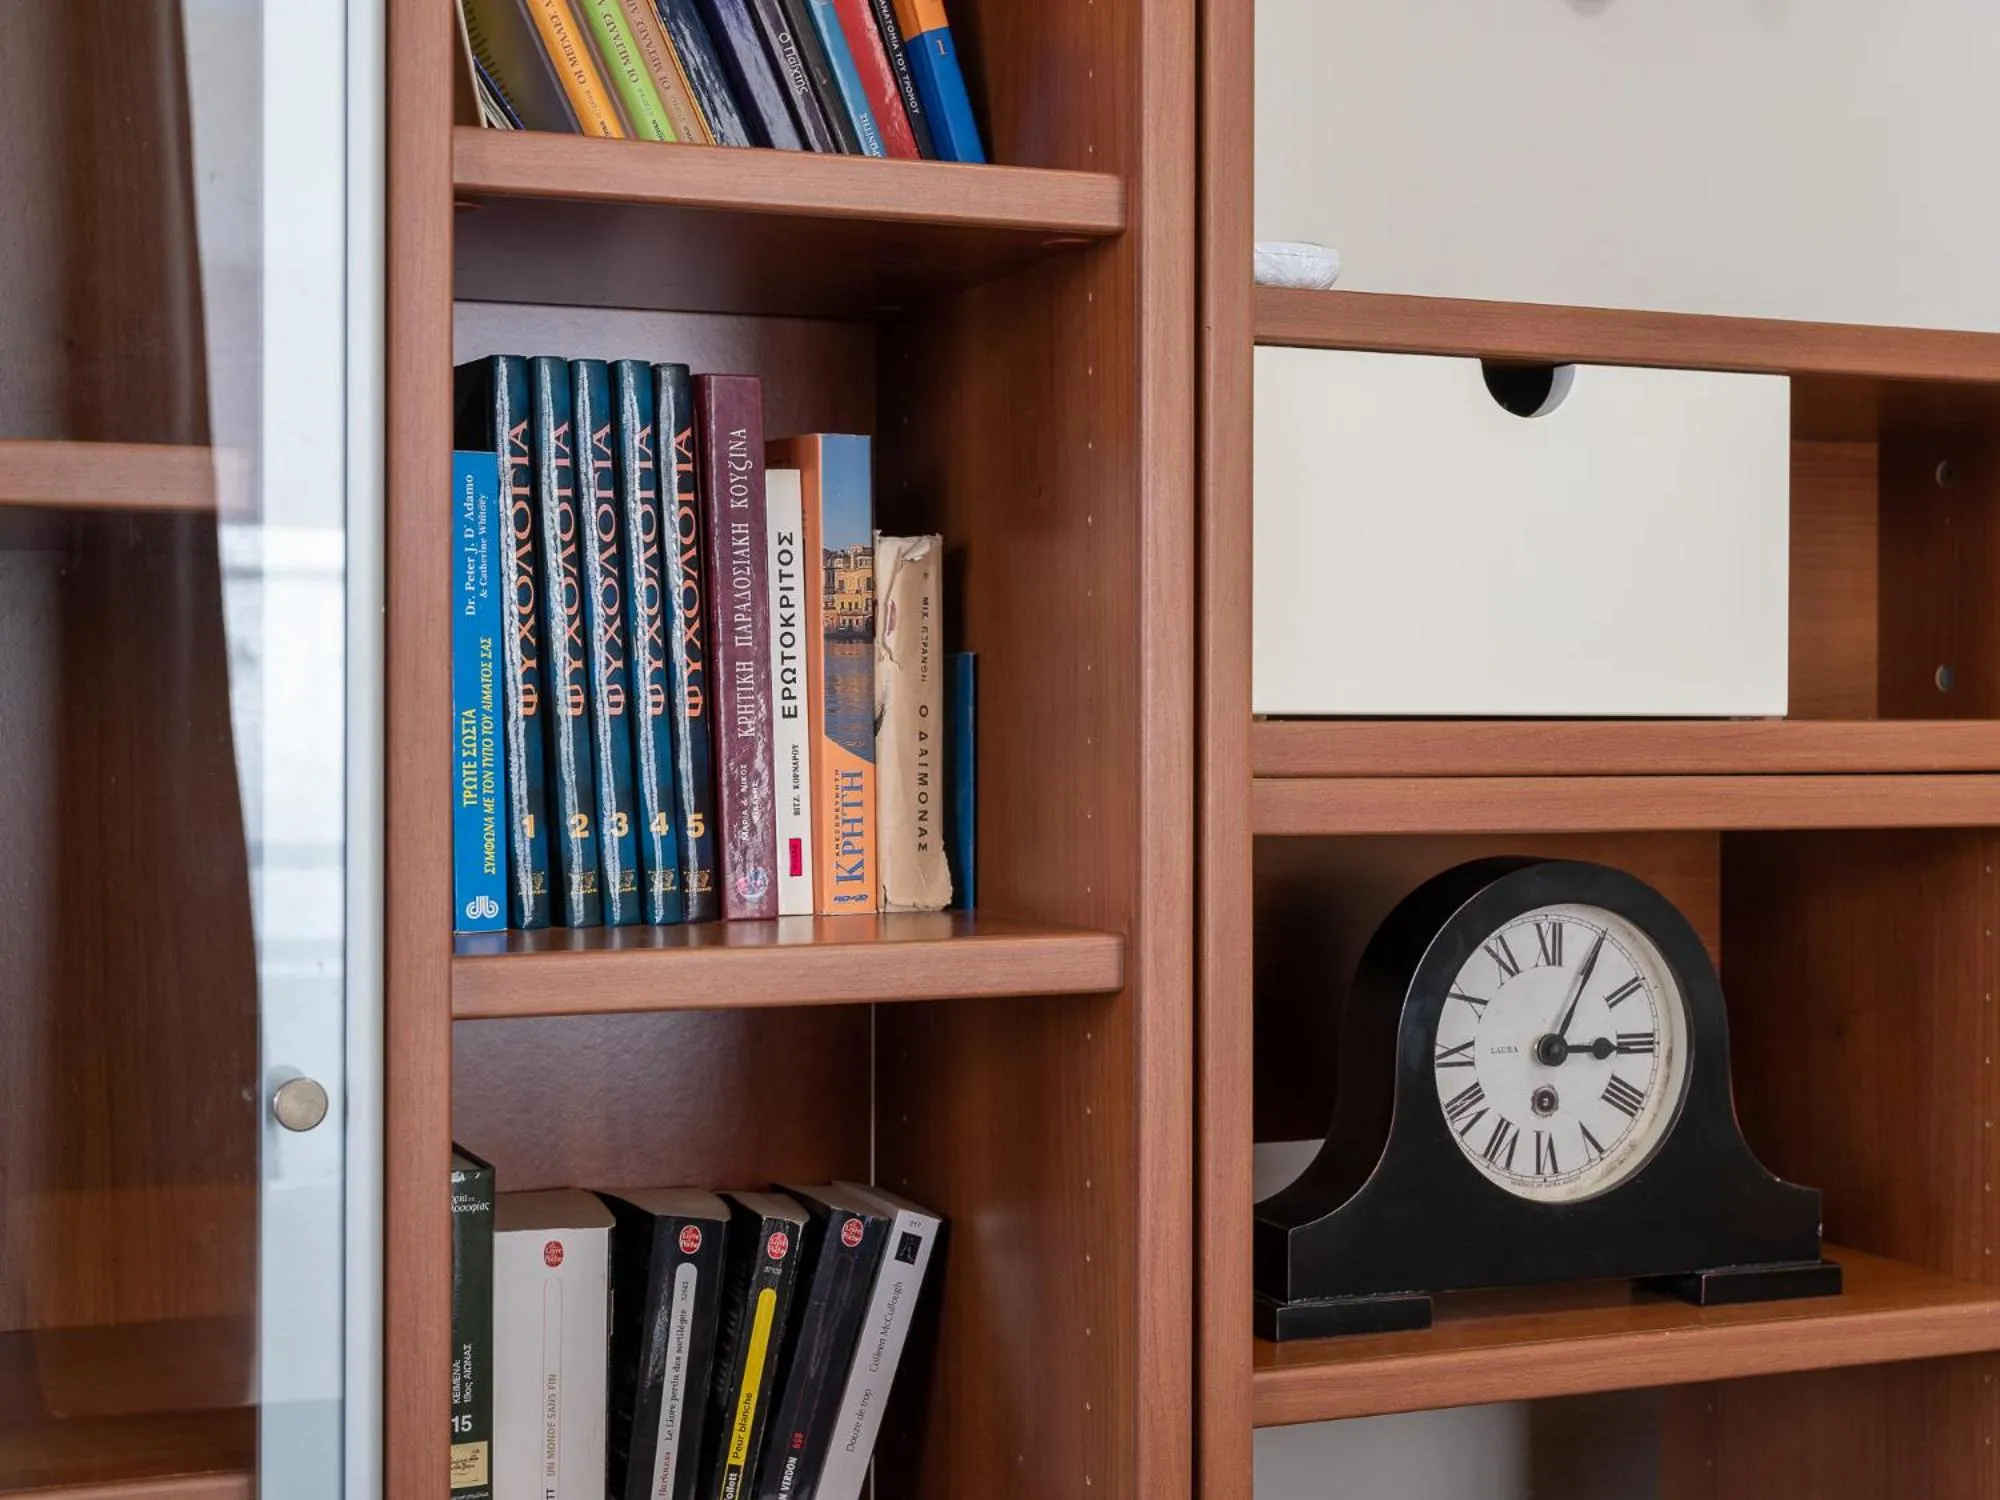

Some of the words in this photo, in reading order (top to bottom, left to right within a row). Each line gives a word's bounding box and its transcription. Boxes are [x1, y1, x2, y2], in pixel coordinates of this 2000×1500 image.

[894, 51, 908, 72] ΤΟΥ
[901, 74, 921, 115] ΤΡΟΜΟΥ
[463, 474, 475, 521] Adamo
[464, 543, 478, 554] J.
[479, 537, 488, 586] Catherine
[464, 556, 476, 591] Peter
[732, 522, 753, 647] ΠΑΡΑΔΟΣΙΑΚΗ
[465, 595, 476, 616] Dr.
[480, 589, 489, 598] &
[777, 532, 798, 719] ΕΡΩΤΟΚΡΙΤΟΣ
[480, 636, 492, 659] ΣΑΣ
[480, 662, 494, 713] ΑΙΜΑΤΟΣ
[736, 661, 755, 738] ΚΡΗΤΙΚΗ
[481, 715, 494, 736] ΤΟΥ
[919, 704, 929, 718] Ο
[461, 708, 477, 758] ΣΩΣΤΑ
[482, 738, 495, 768] ΤΥΠΟ
[790, 744, 800, 790] ΚΟΡΝΑΡΟΥ
[462, 761, 478, 808] ΤΡΩΤΕ
[482, 770, 495, 795] ΤΟΝ
[918, 731, 929, 852] ΔΑΙΜΟΝΑΣ
[482, 797, 495, 814] ΜΕ
[522, 814, 536, 838] 1
[570, 814, 589, 838] 2
[611, 812, 629, 838] 3
[650, 812, 668, 836] 4
[687, 813, 705, 838] 5
[835, 769, 865, 884] ΚΡΗΤΗ
[483, 816, 496, 874] ΣΥΜΦΩΝΑ
[1535, 922, 1563, 967] XII
[463, 1343, 472, 1380] ΑΙΩΝΑΣ
[869, 1338, 887, 1373] Colleen
[547, 1373, 557, 1390] FIN
[671, 1377, 680, 1402] perdu
[547, 1393, 556, 1420] SANS
[860, 1388, 874, 1408] trop
[451, 1414, 473, 1433] 15
[855, 1408, 866, 1421] de
[546, 1422, 556, 1460] MONDE
[846, 1421, 862, 1453] Douze
[780, 1456, 798, 1491] VERDON
